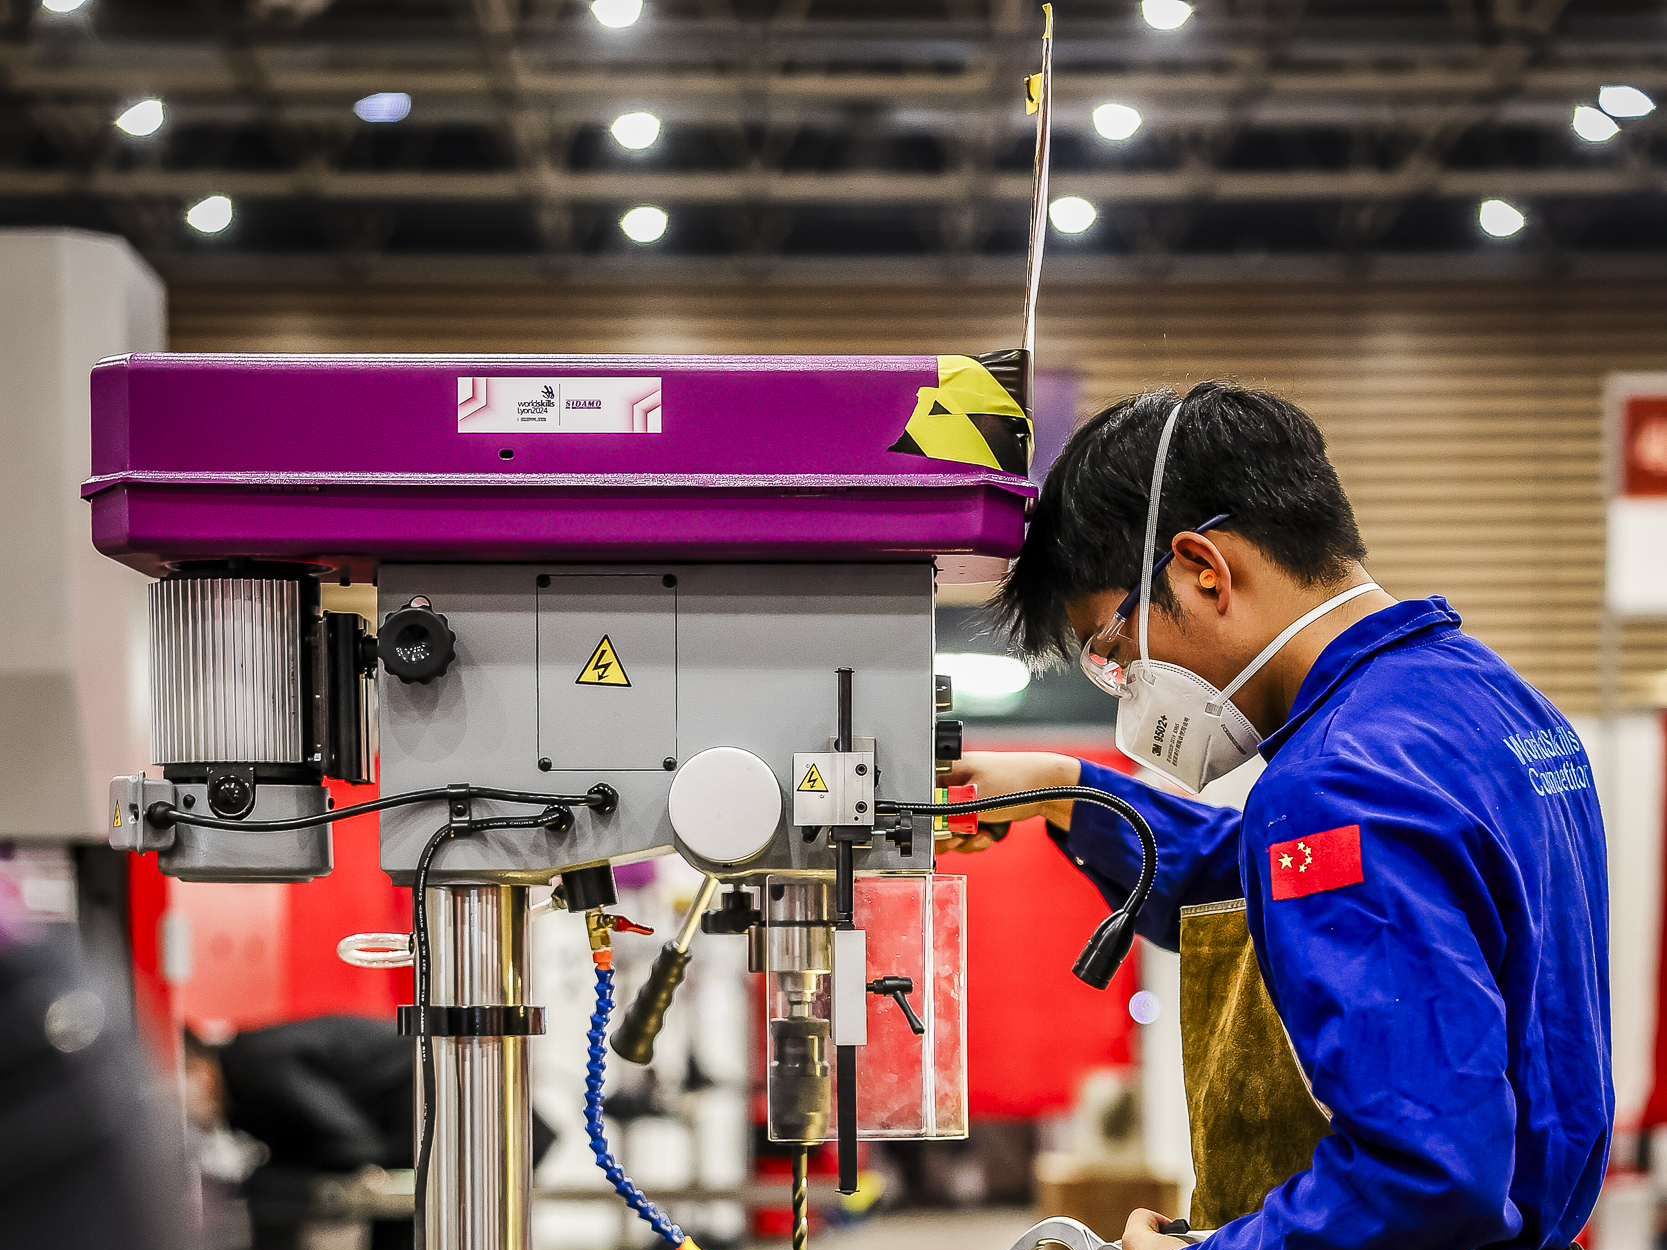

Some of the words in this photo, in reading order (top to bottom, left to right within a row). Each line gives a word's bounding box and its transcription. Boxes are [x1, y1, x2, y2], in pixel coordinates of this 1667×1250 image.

[517, 399, 555, 408] worldskills
[565, 399, 602, 408] SIDAMO
[1153, 714, 1168, 743] 9502+
[1151, 743, 1162, 757] 3M
